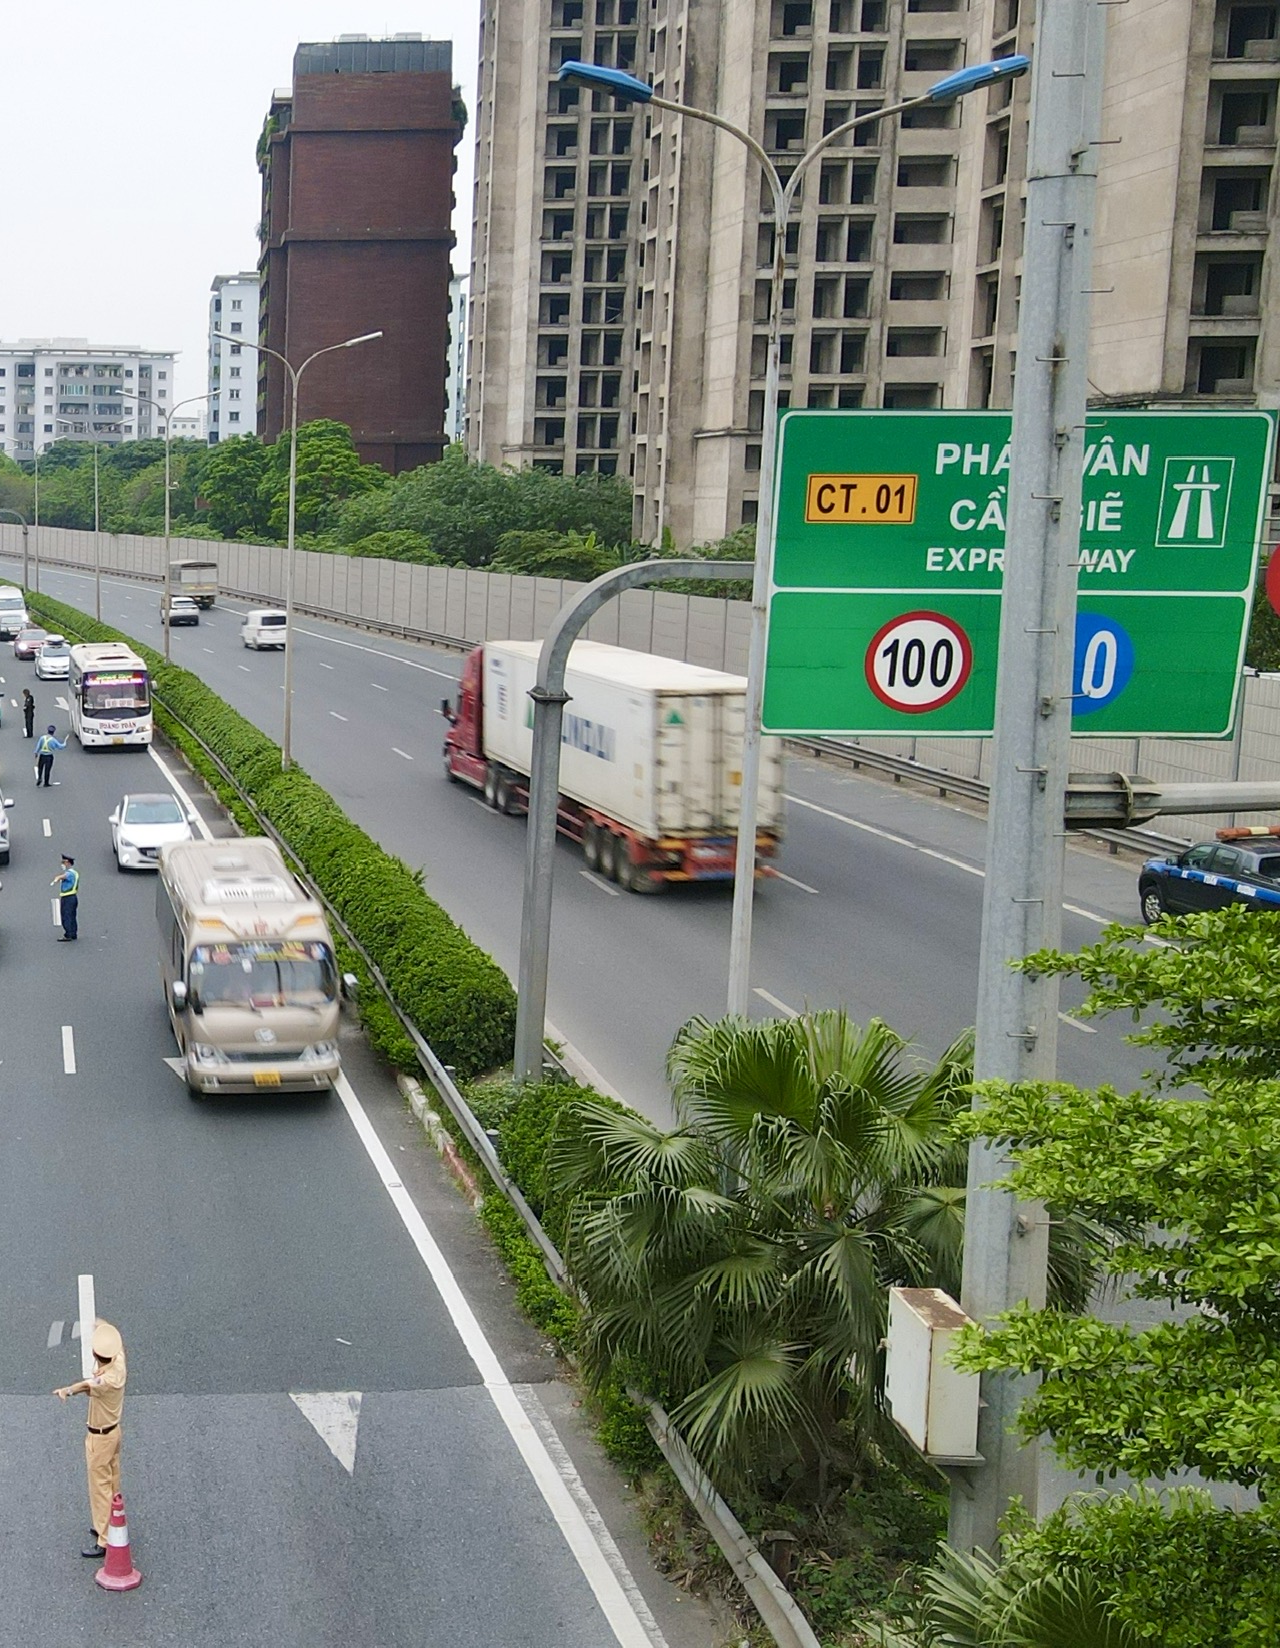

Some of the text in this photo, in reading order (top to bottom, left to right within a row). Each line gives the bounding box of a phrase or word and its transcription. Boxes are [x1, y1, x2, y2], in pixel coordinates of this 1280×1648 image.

[816, 483, 906, 514] CT.01
[925, 547, 1136, 573] EXPRWAY
[882, 638, 954, 688] 100
